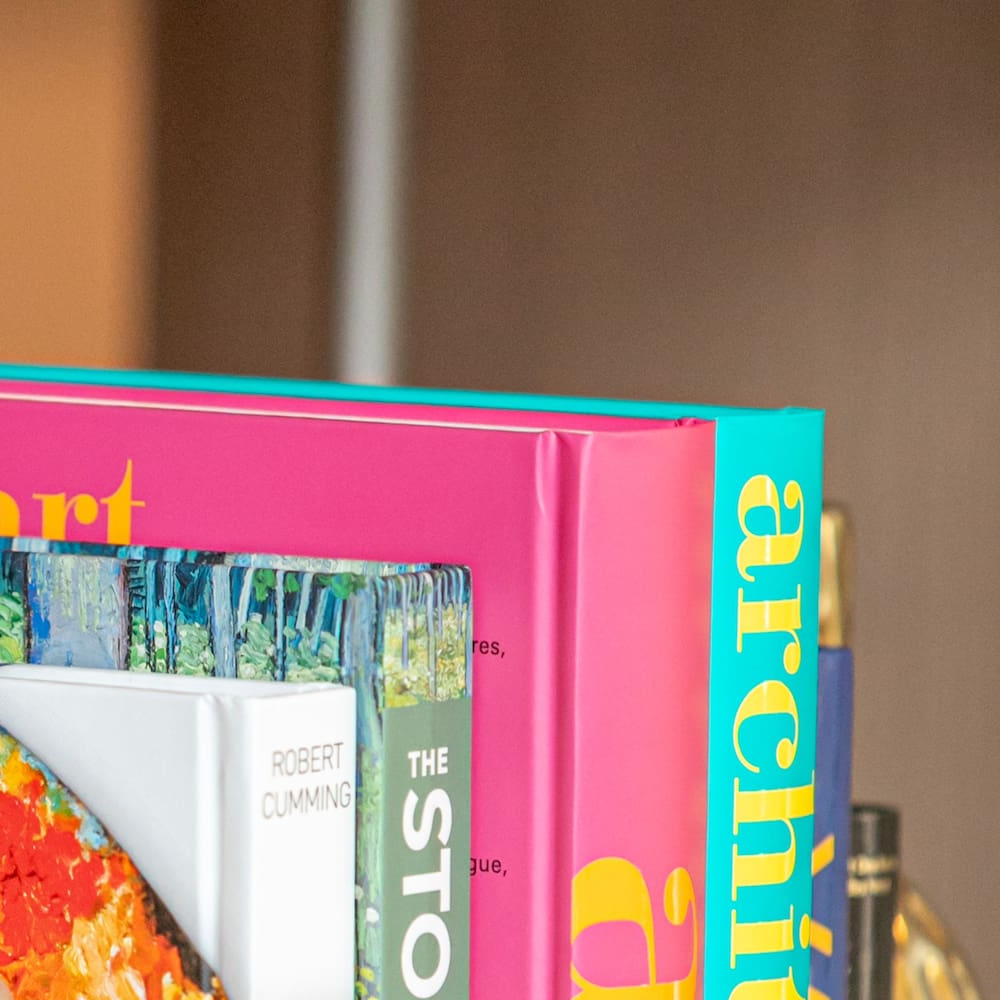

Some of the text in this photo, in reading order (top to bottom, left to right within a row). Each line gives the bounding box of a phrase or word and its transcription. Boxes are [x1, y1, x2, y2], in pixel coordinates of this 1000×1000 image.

[271, 742, 344, 777] ROBERT
[408, 746, 449, 778] THE
[261, 781, 352, 820] CUMMING
